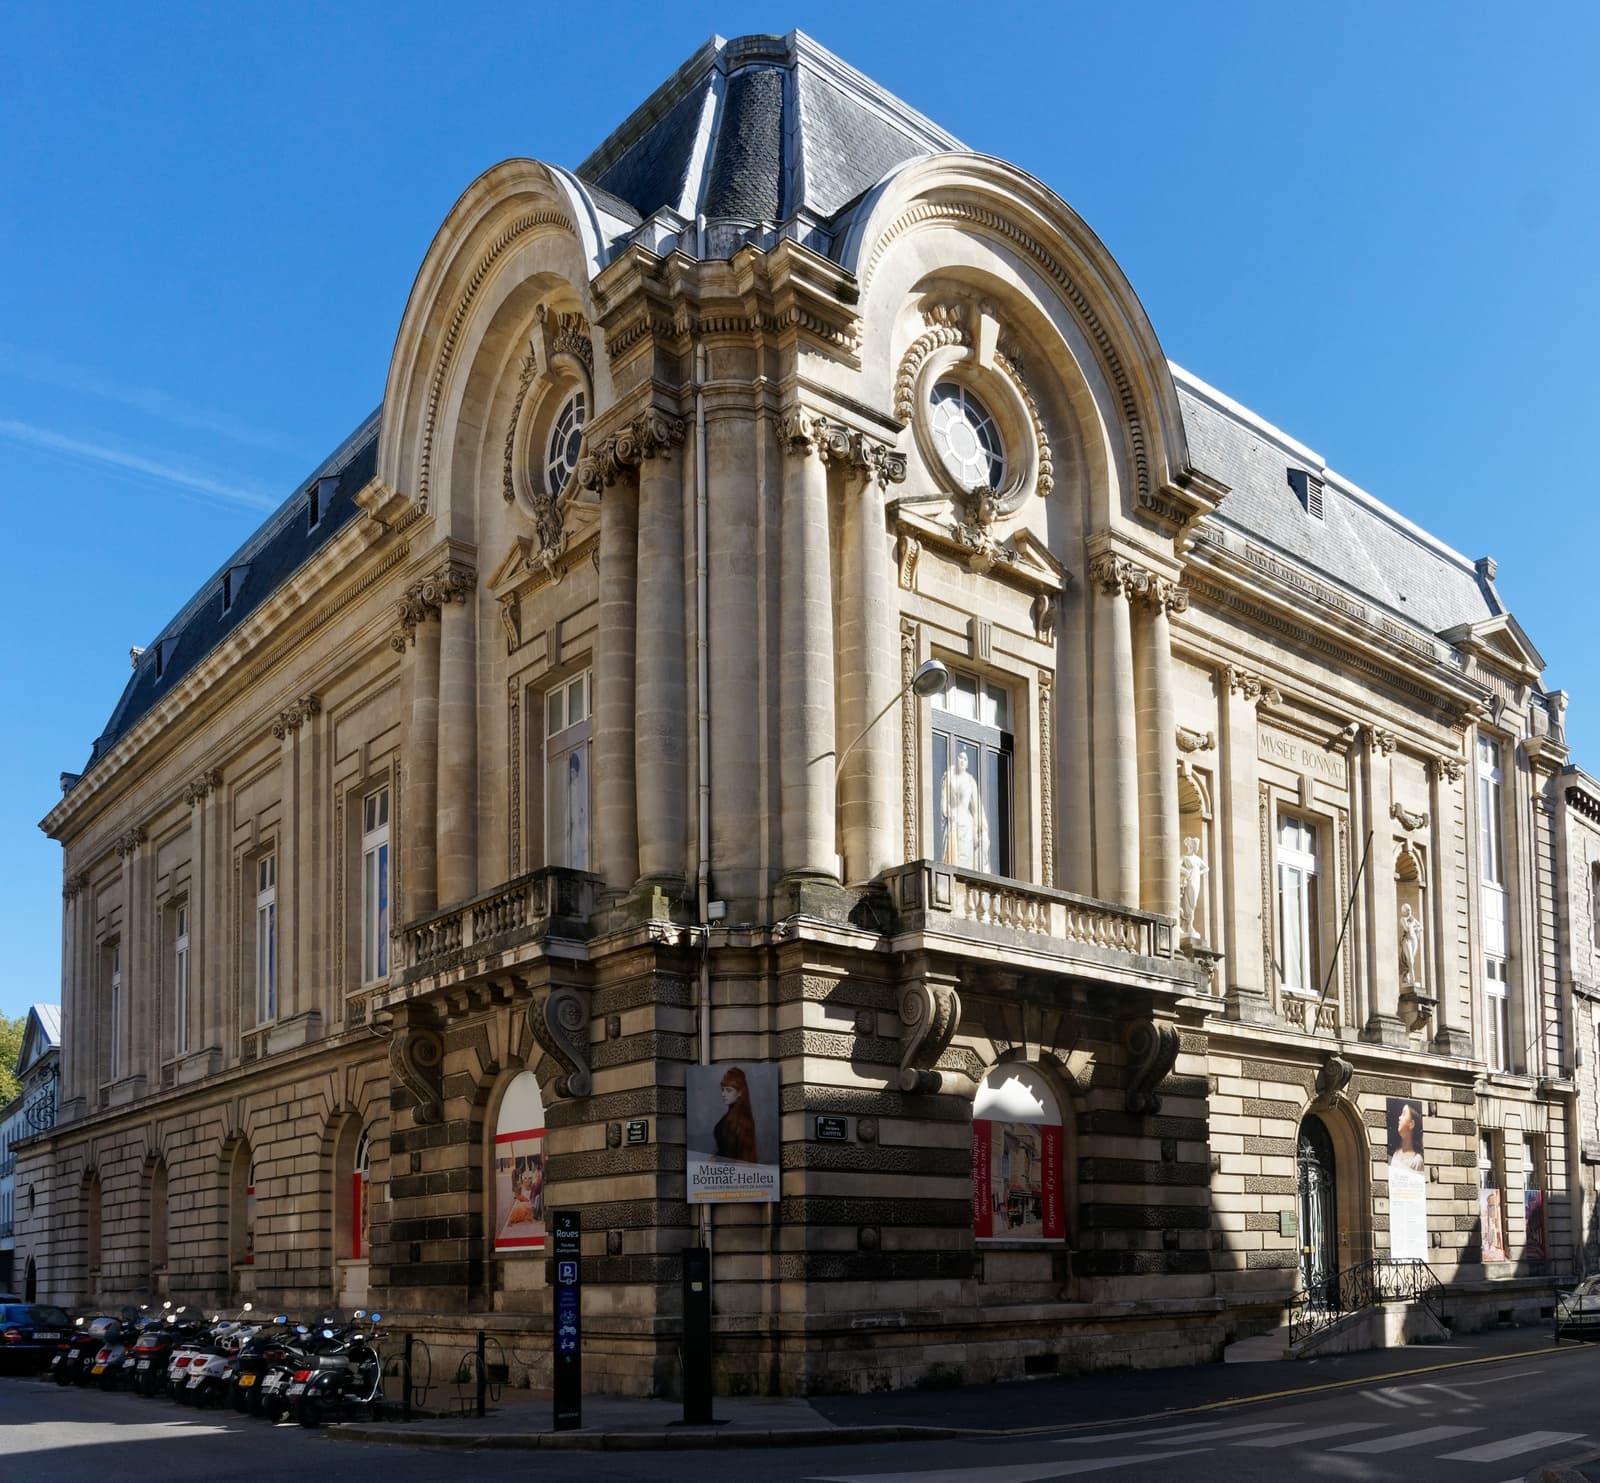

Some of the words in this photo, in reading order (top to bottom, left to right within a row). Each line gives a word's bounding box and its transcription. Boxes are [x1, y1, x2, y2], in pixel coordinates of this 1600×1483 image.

[1302, 749, 1343, 779] BONNAT
[700, 1164, 736, 1175] Musée
[693, 1173, 774, 1185] Bonnat-Helleu
[565, 1219, 571, 1228] 2
[557, 1229, 579, 1238] Roues
